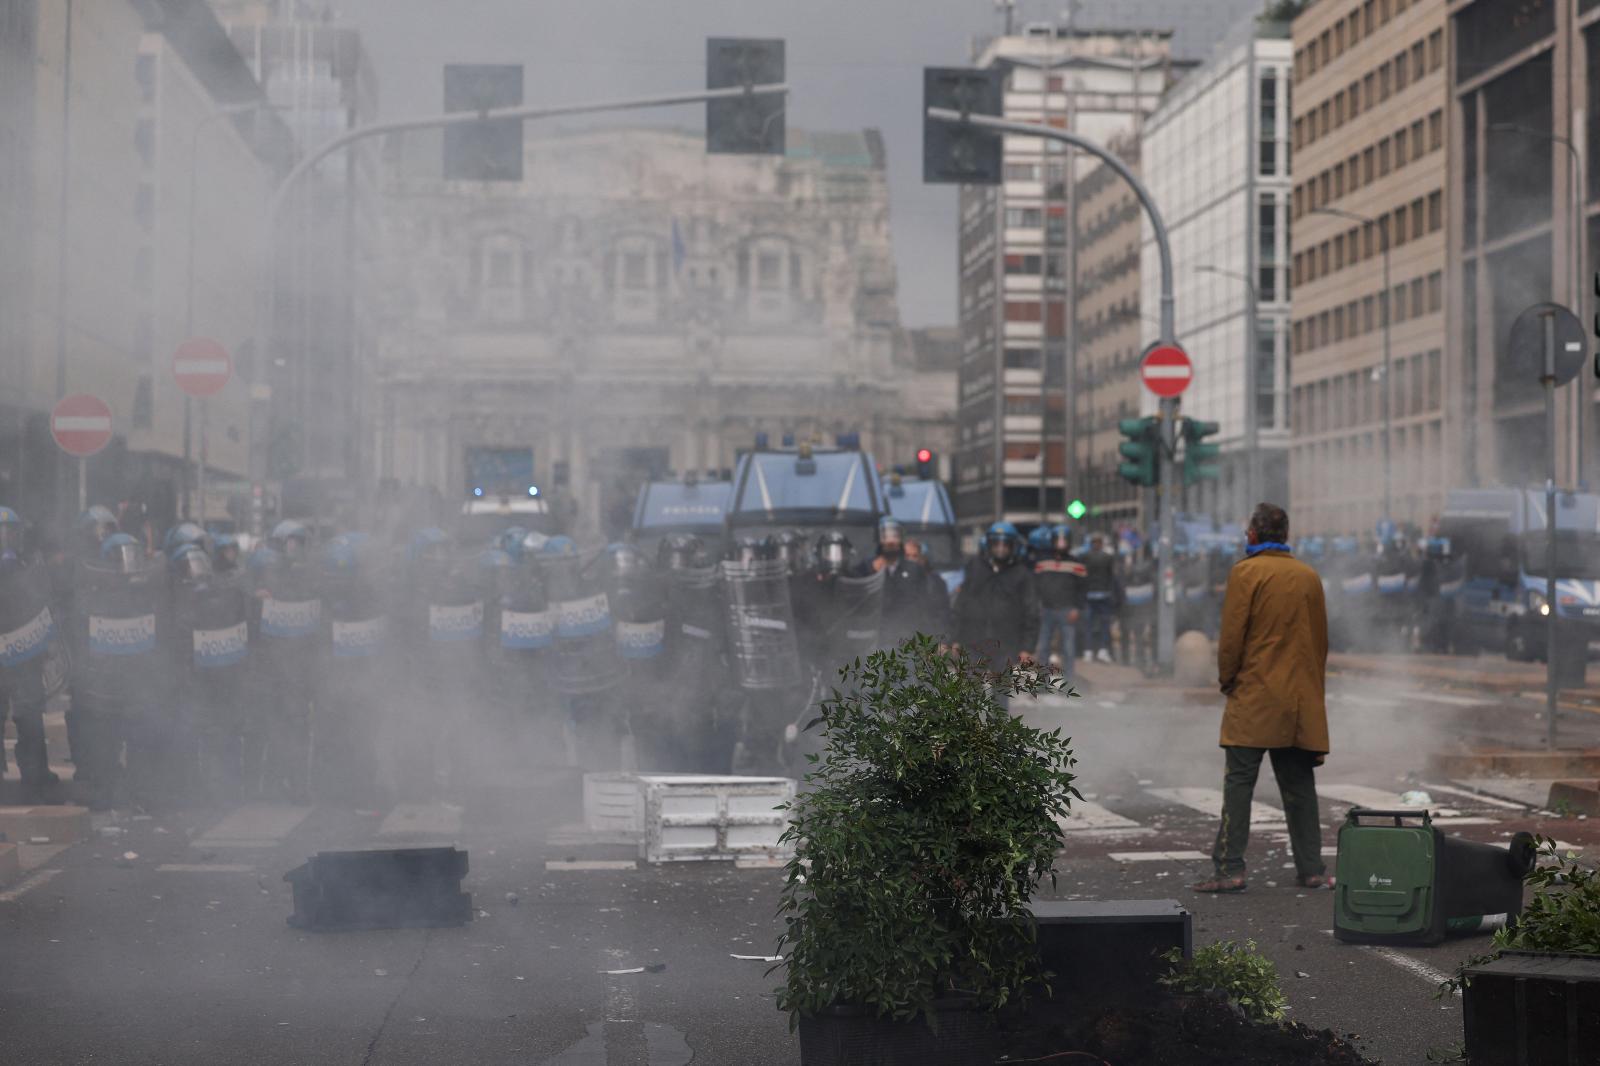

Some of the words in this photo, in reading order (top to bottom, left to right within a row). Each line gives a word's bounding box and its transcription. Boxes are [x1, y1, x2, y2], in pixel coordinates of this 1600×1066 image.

[96, 626, 149, 643] POLIZIA
[508, 622, 551, 638] POLIZ
[623, 630, 662, 648] POLIZ
